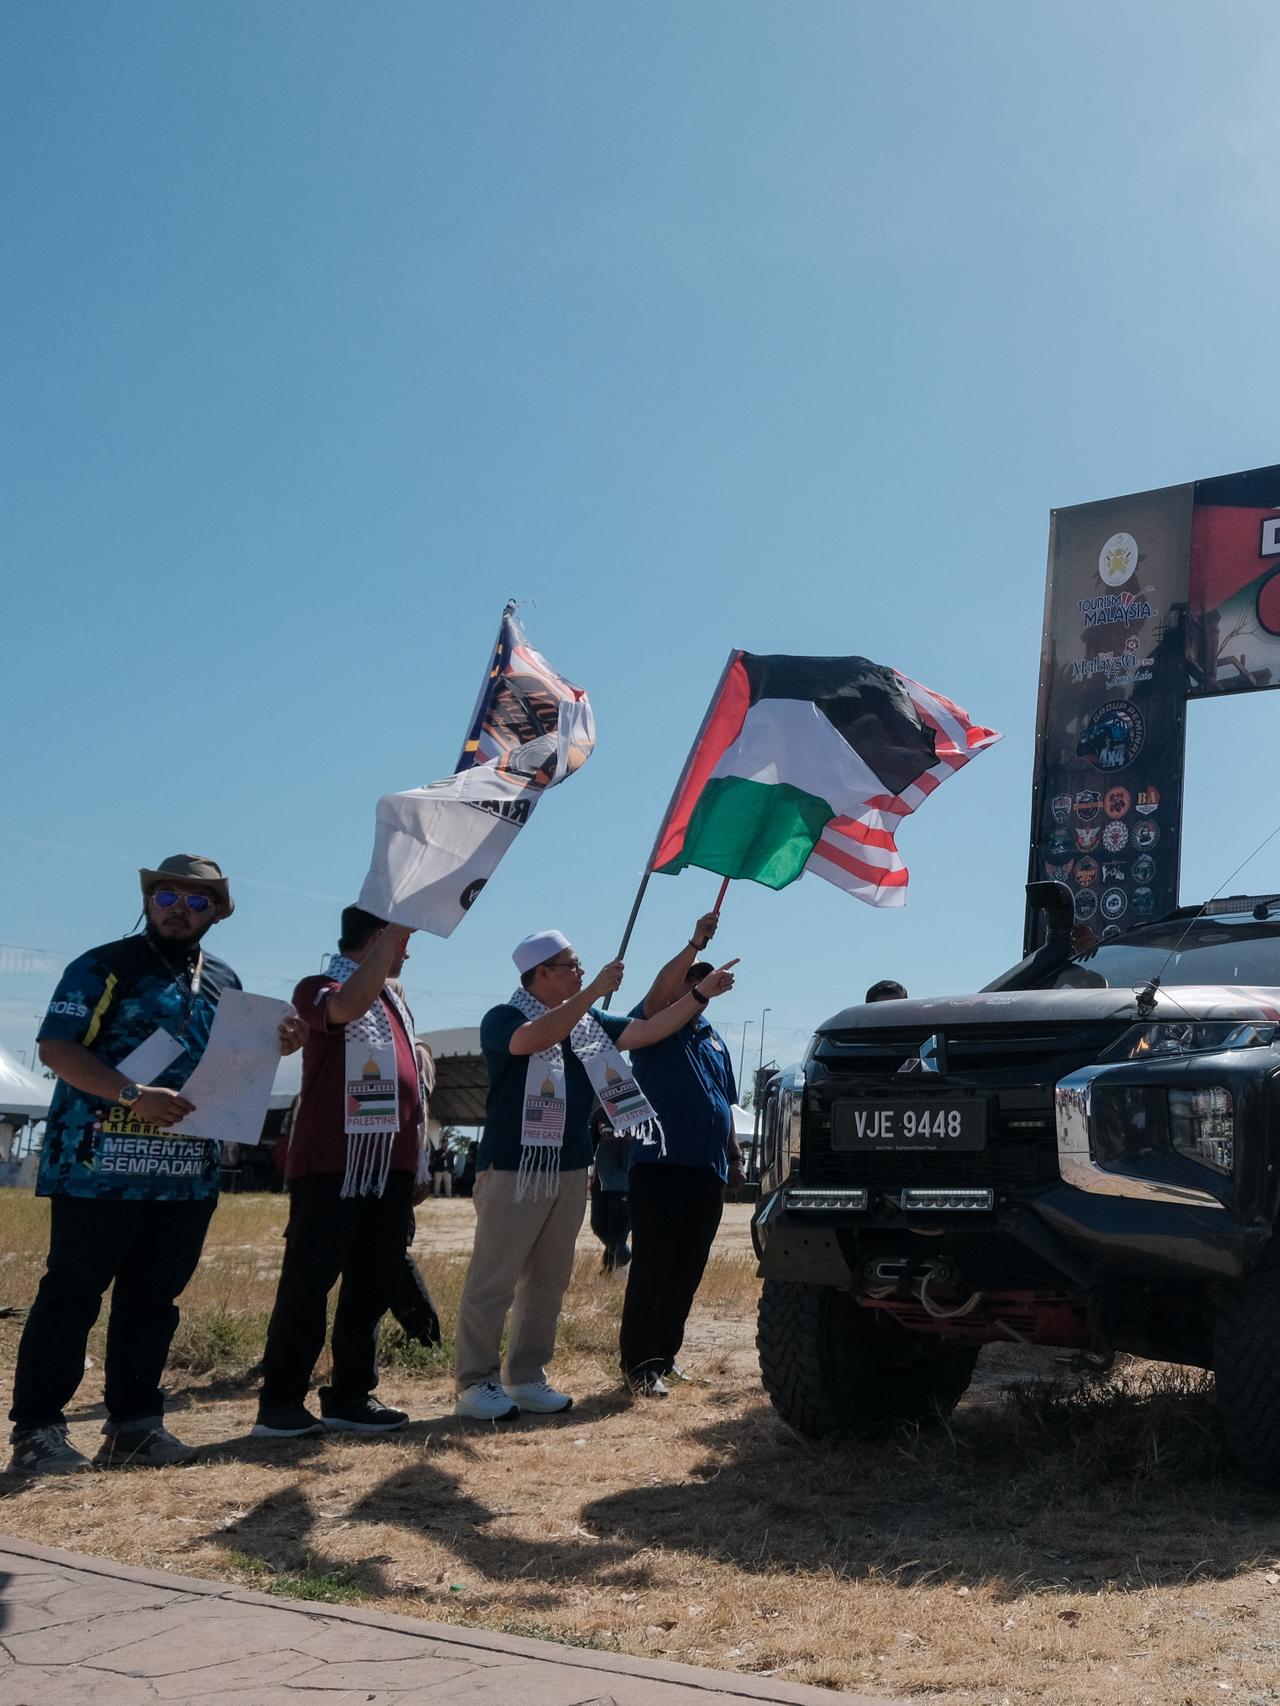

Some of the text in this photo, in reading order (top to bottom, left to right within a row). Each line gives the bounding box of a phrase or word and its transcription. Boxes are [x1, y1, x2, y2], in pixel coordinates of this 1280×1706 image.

[1078, 594, 1121, 611] TOURISM
[1084, 602, 1152, 628] MALAYSIA
[1093, 702, 1127, 722] GROUP
[347, 1116, 397, 1126] PALESTINE
[854, 1110, 961, 1138] VJE 9448
[523, 1129, 541, 1139] FREE
[100, 1157, 201, 1175] SEMPADAN
